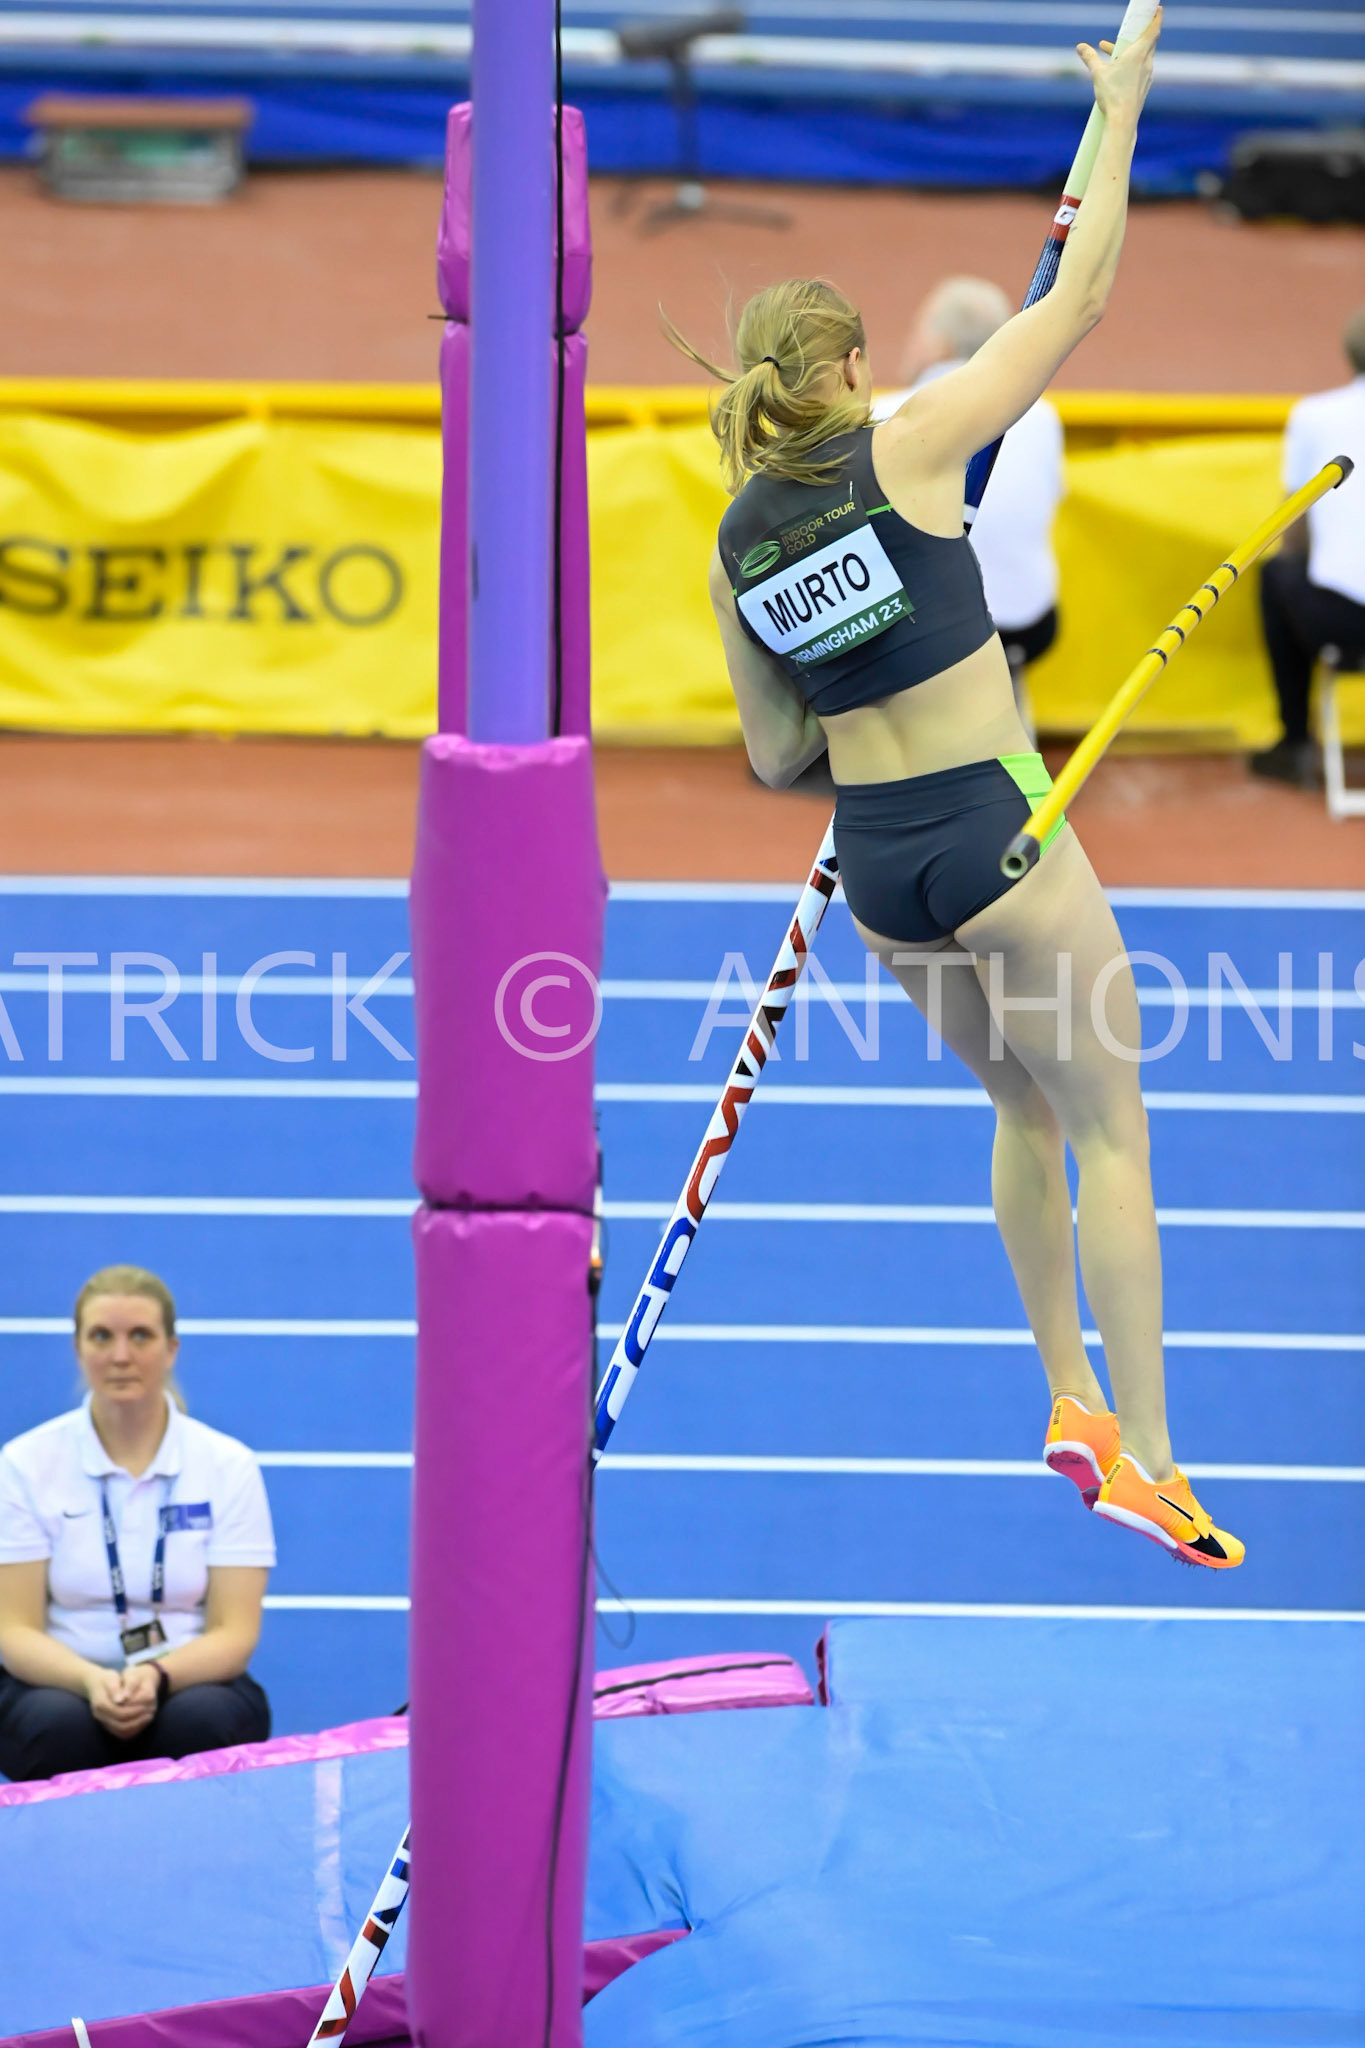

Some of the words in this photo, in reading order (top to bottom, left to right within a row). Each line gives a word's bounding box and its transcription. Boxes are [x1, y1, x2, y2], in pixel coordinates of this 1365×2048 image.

[781, 517, 825, 546] INDOOR
[824, 501, 856, 522] TOUR
[786, 533, 817, 556] GOLD
[0, 535, 405, 628] SEIKO
[762, 552, 871, 637] MURTO
[878, 597, 904, 622] 23
